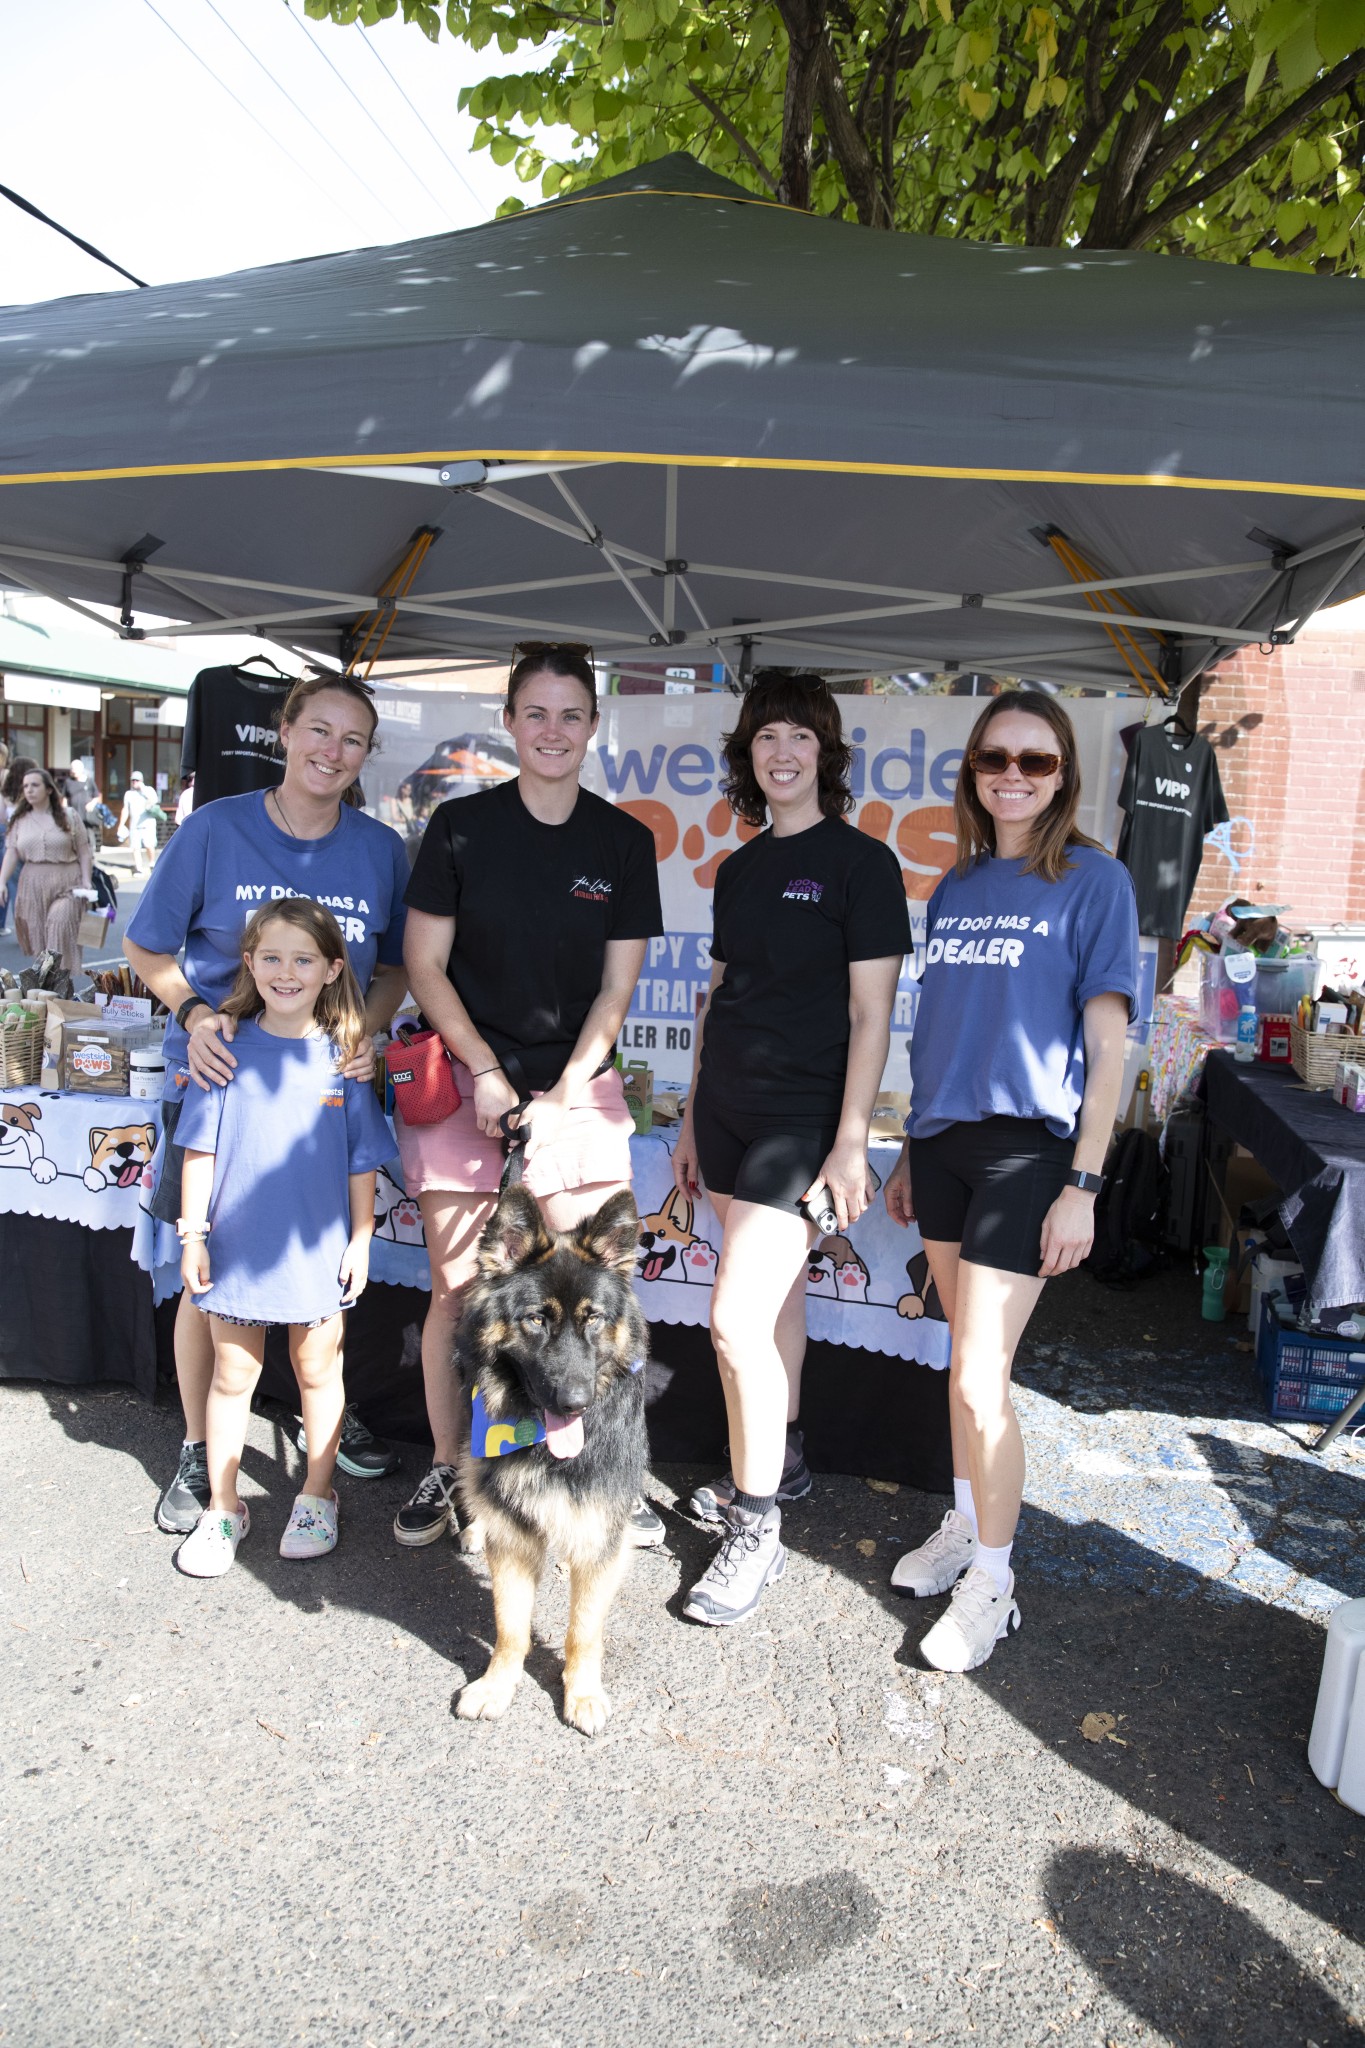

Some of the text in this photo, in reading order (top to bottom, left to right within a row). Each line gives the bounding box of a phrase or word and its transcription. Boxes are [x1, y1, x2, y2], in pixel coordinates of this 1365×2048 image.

[235, 724, 277, 746] VIPP
[592, 727, 958, 801] weide
[1155, 776, 1190, 800] VIPP
[782, 891, 810, 901] PETS
[786, 885, 812, 893] LEAD
[789, 879, 824, 893] LOOSE
[235, 884, 266, 901] MY
[316, 895, 354, 911] HAS
[357, 899, 370, 915] A
[934, 915, 1049, 937] MY DOG HAS A
[926, 937, 1025, 968] DEALER
[101, 1006, 145, 1019] Bully Sticks
[622, 1024, 657, 1049] LER
[74, 1052, 111, 1061] westside
[393, 1071, 411, 1081] DOOG
